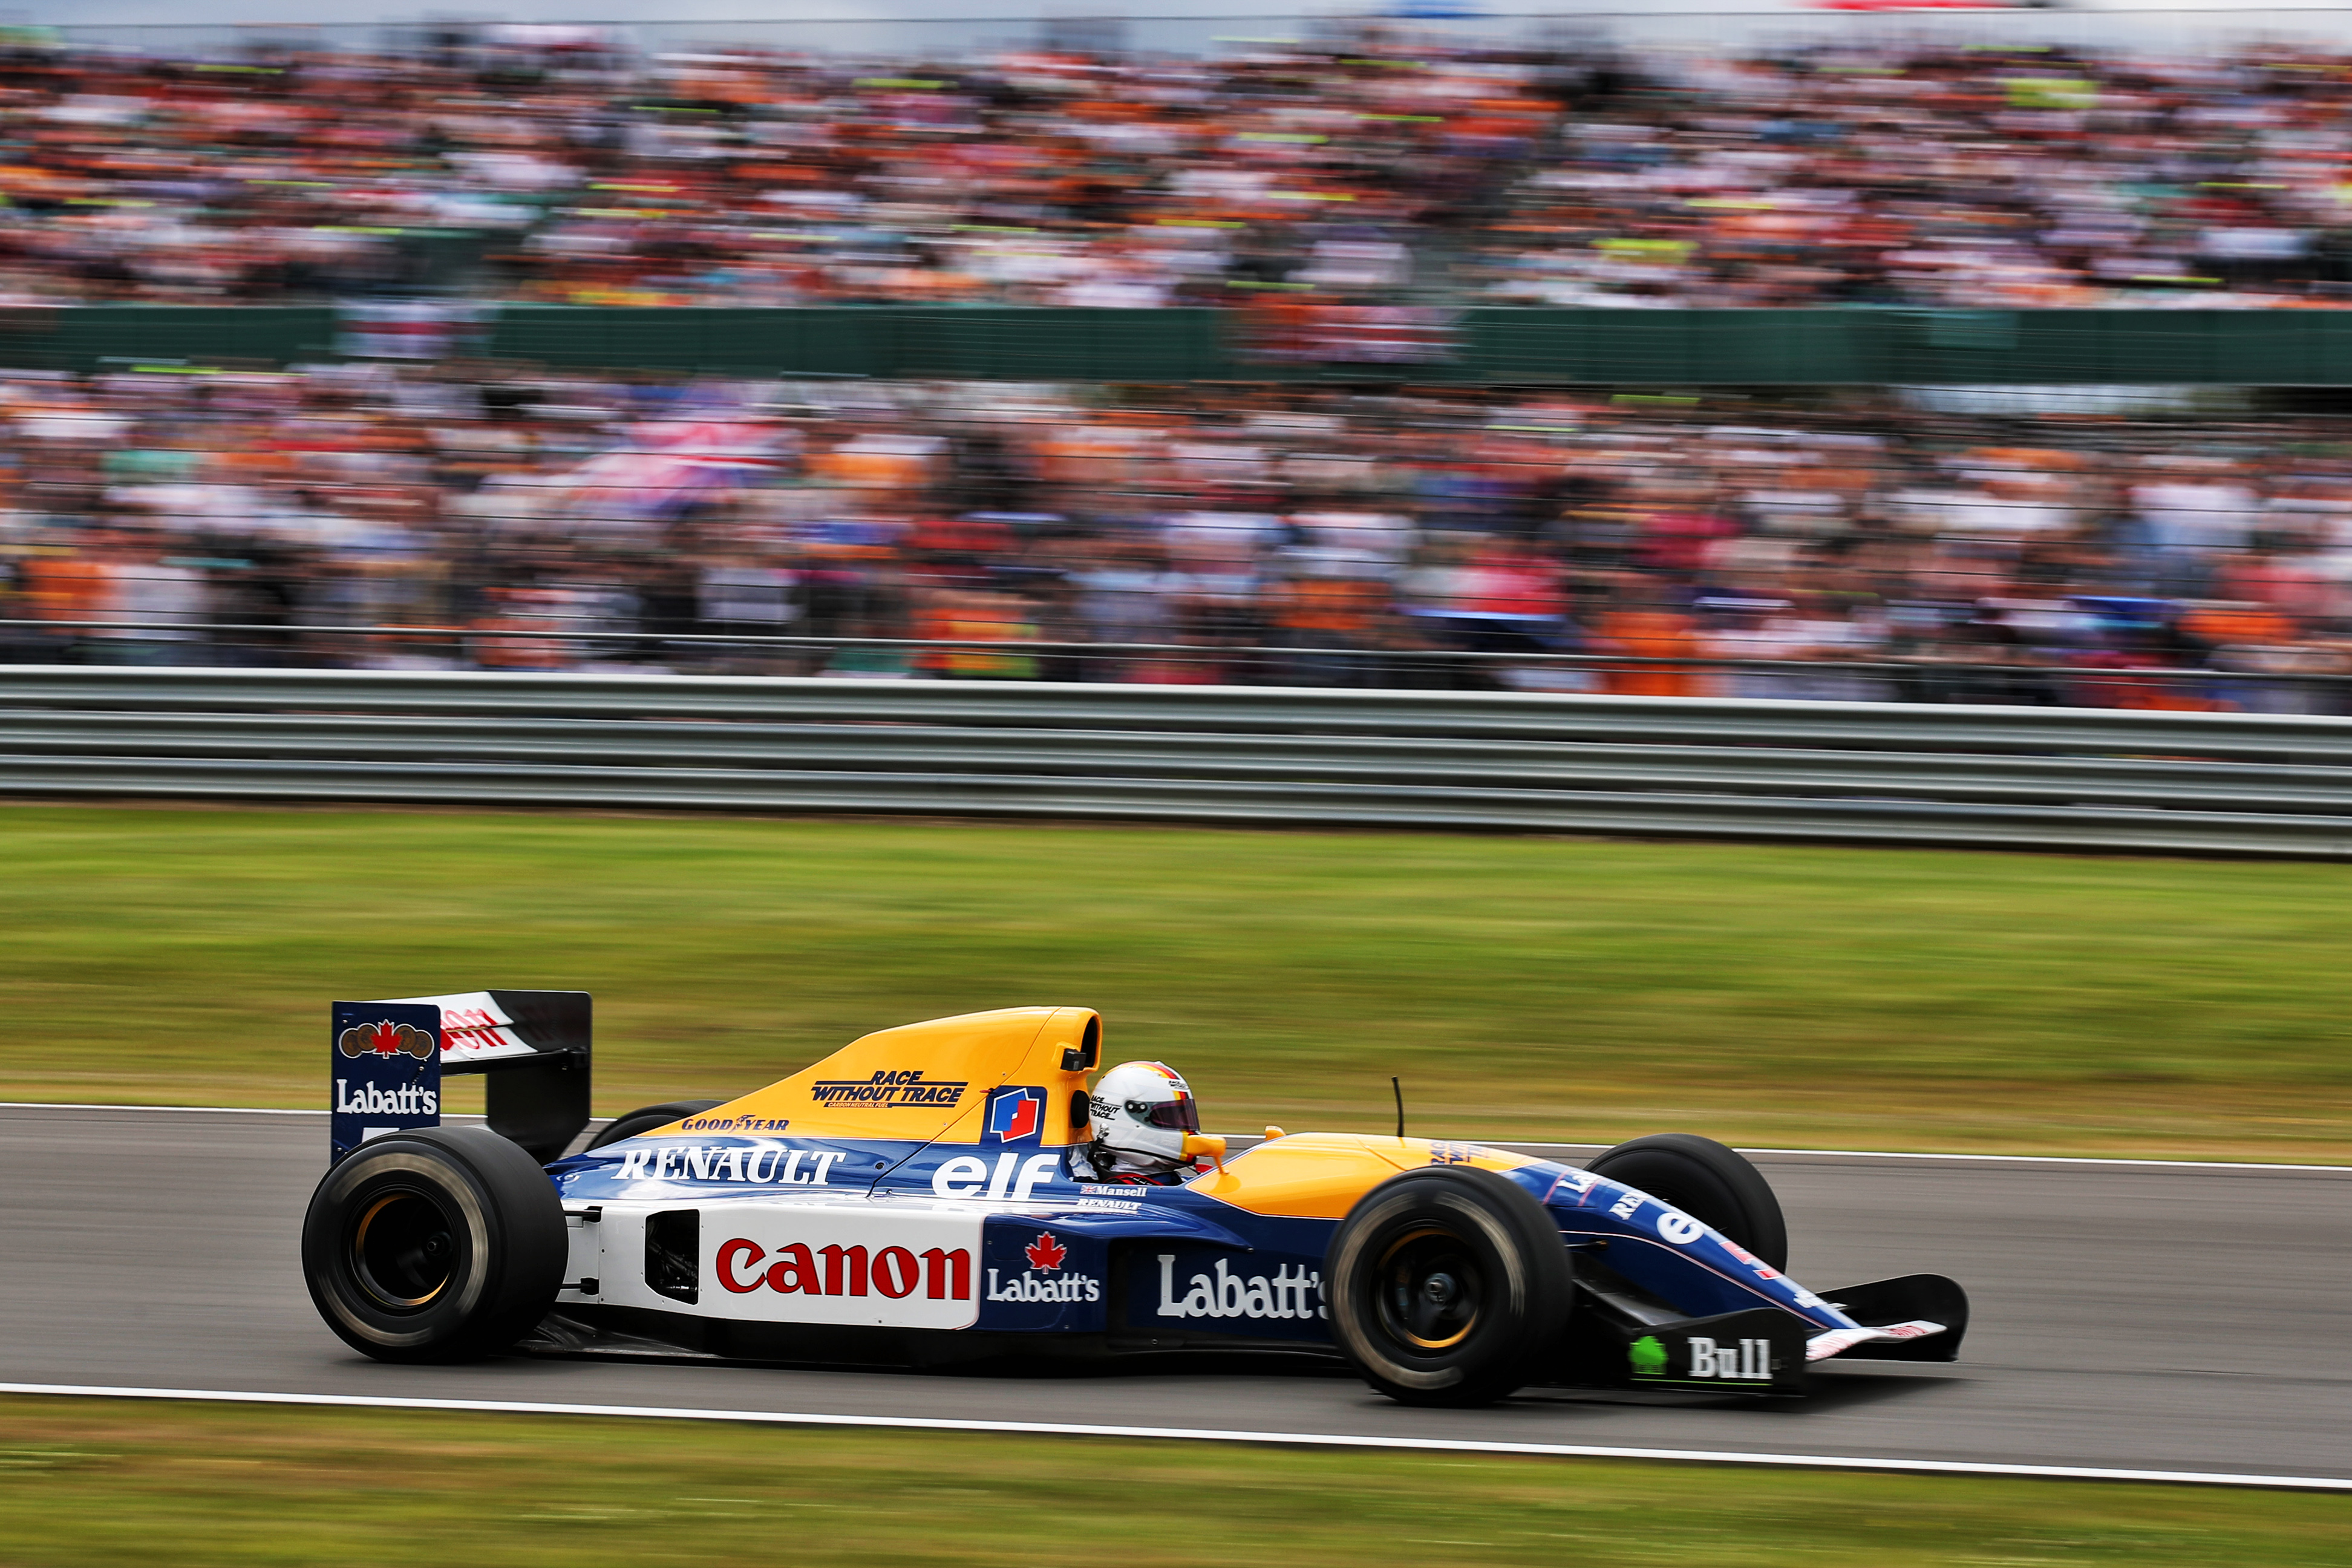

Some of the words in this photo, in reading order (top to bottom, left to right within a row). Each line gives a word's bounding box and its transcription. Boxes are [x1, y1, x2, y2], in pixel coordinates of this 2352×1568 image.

[811, 1086, 901, 1101] WITHOUT
[900, 1087, 966, 1102] TRACE
[871, 1071, 924, 1085] RACE
[336, 1079, 437, 1115] Labatt's
[610, 1146, 846, 1186] RENAULT
[932, 1152, 1061, 1201] elf
[1077, 1198, 1143, 1210] RENAULT
[1096, 1186, 1148, 1197] Mansell
[716, 1238, 970, 1301] Canon
[987, 1268, 1100, 1302] Labatt's
[1687, 1337, 1774, 1379] Bull
